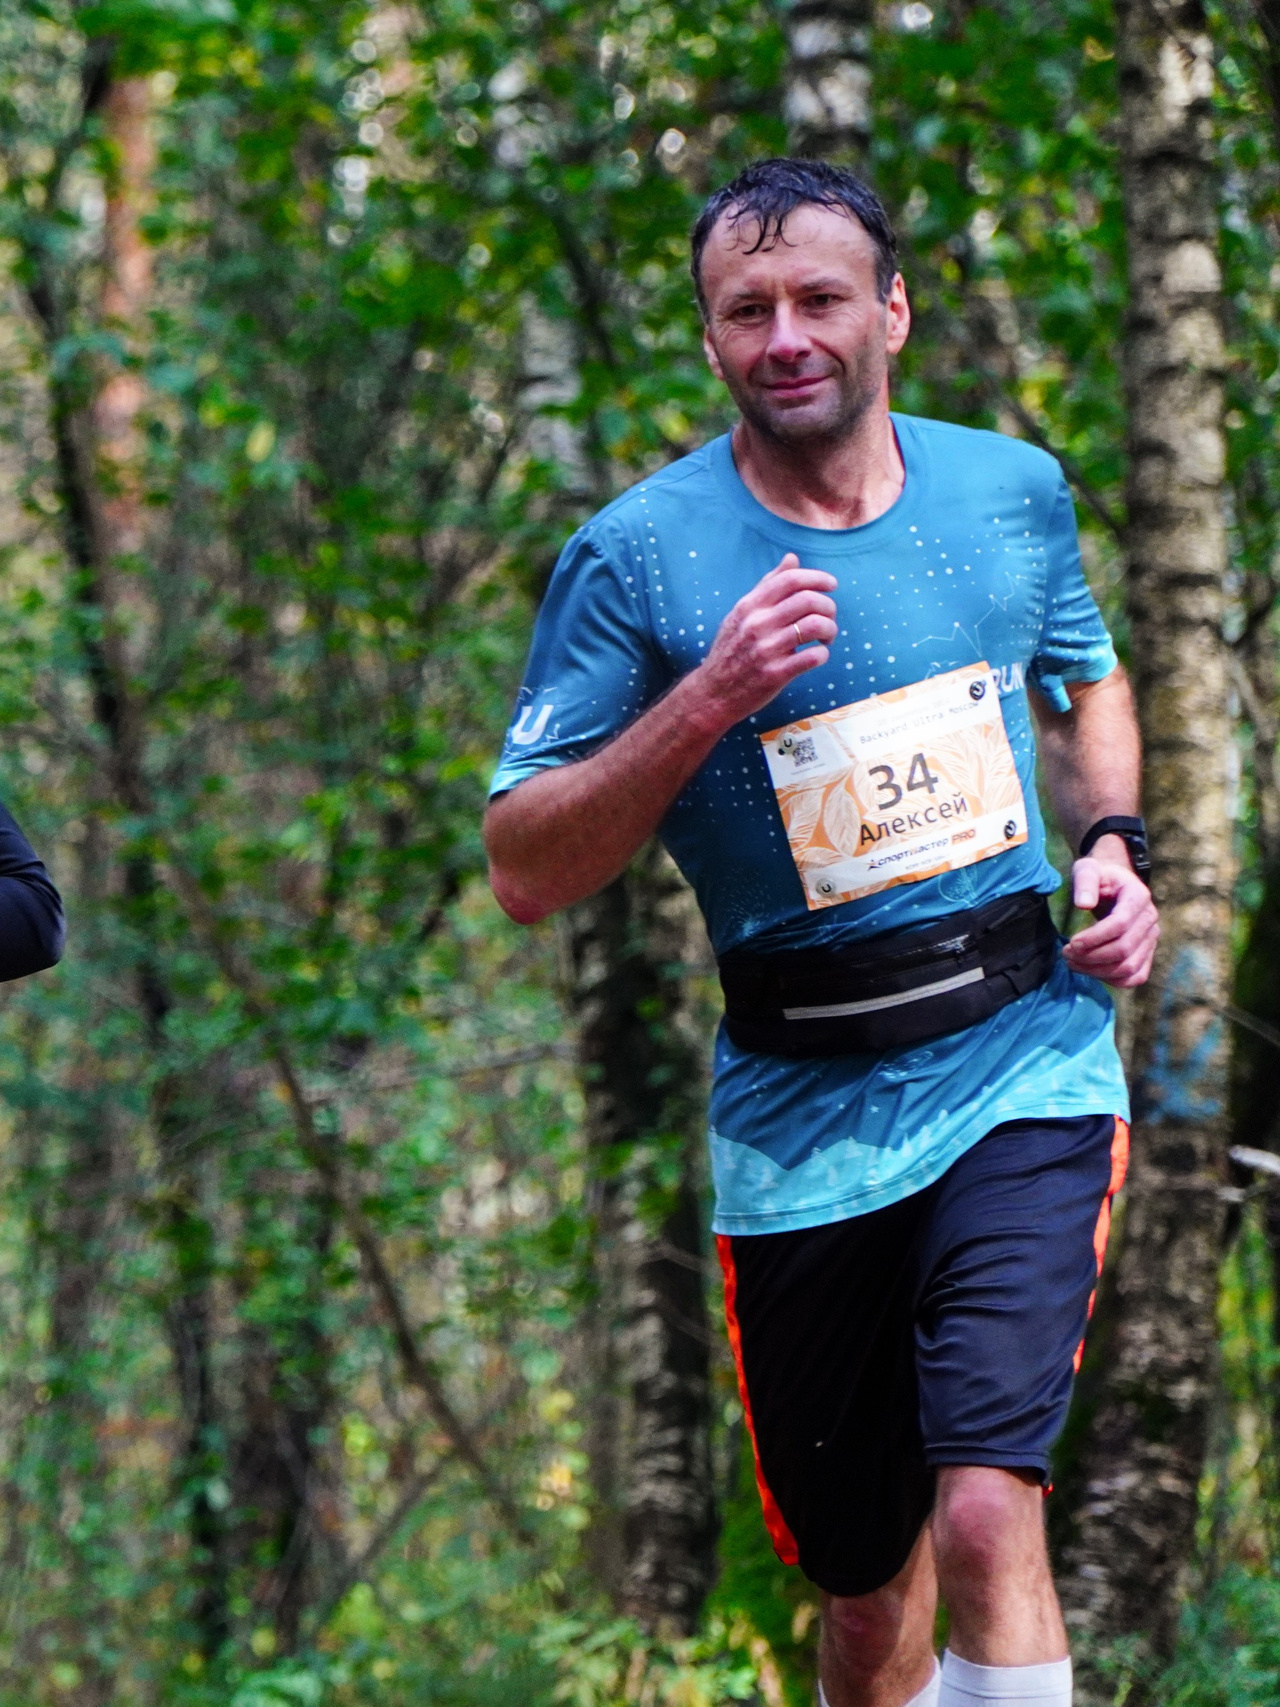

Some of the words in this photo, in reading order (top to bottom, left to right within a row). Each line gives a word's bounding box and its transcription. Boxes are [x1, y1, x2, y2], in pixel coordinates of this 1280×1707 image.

[511, 704, 554, 745] U
[859, 721, 908, 744] Backyard
[868, 752, 938, 811] 34
[860, 791, 968, 846] Алексей
[952, 829, 977, 845] PRO
